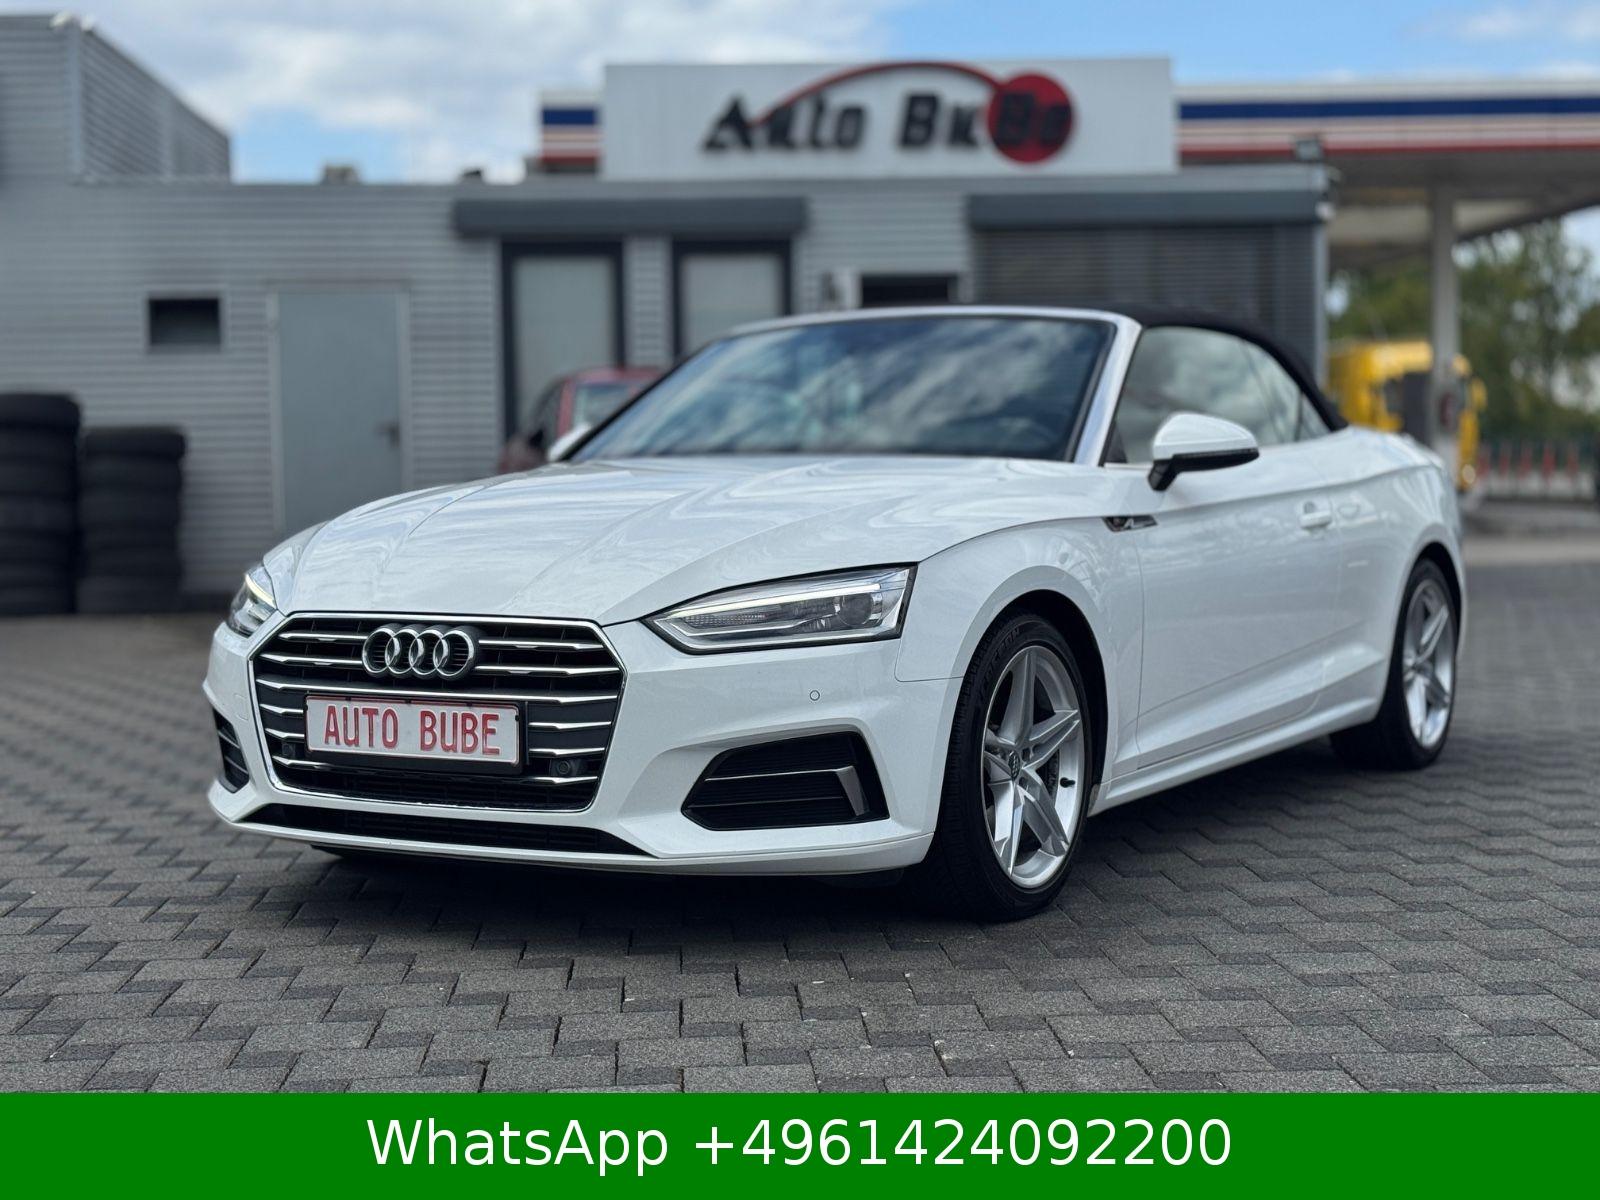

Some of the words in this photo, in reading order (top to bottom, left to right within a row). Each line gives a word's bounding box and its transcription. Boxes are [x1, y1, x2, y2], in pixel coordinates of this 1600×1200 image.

[704, 94, 865, 150] Auto
[323, 704, 400, 750] AUTO
[419, 709, 501, 756] BUBE
